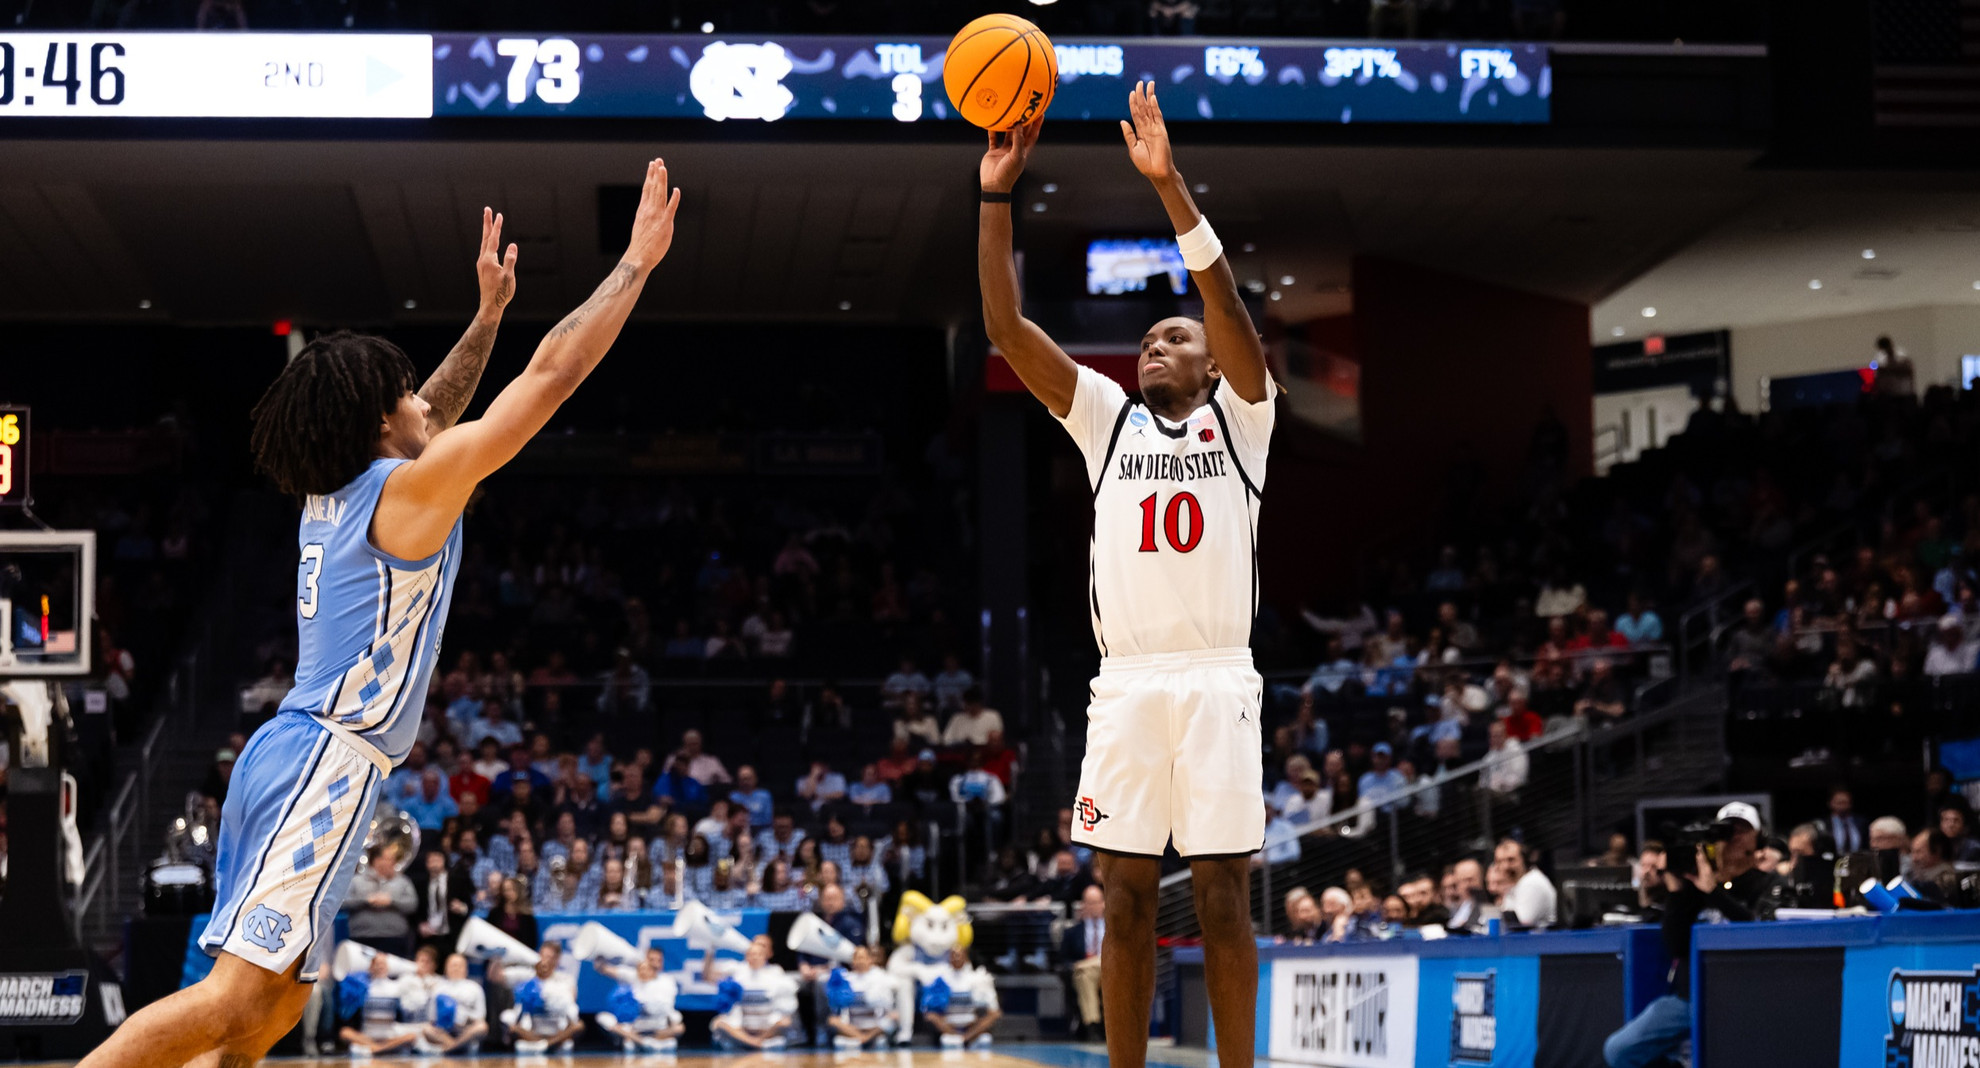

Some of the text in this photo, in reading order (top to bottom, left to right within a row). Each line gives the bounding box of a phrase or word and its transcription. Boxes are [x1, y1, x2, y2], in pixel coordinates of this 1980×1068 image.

[264, 62, 324, 87] 2ND
[497, 38, 580, 104] 73
[1053, 45, 1123, 76] ONUS
[1205, 47, 1264, 77] FG%
[1324, 48, 1401, 78] 3PT%
[1460, 49, 1517, 79] FT%
[892, 73, 922, 122] 3
[0, 414, 20, 445] 6
[1118, 450, 1227, 482] SAN DIEGO STATE
[304, 494, 347, 528] ADEAU
[1138, 491, 1204, 553] 10
[299, 542, 324, 619] 3
[0, 994, 82, 1017] MADNESS
[1905, 981, 1962, 1032] MARCH
[1912, 1032, 1980, 1068] MADNES
